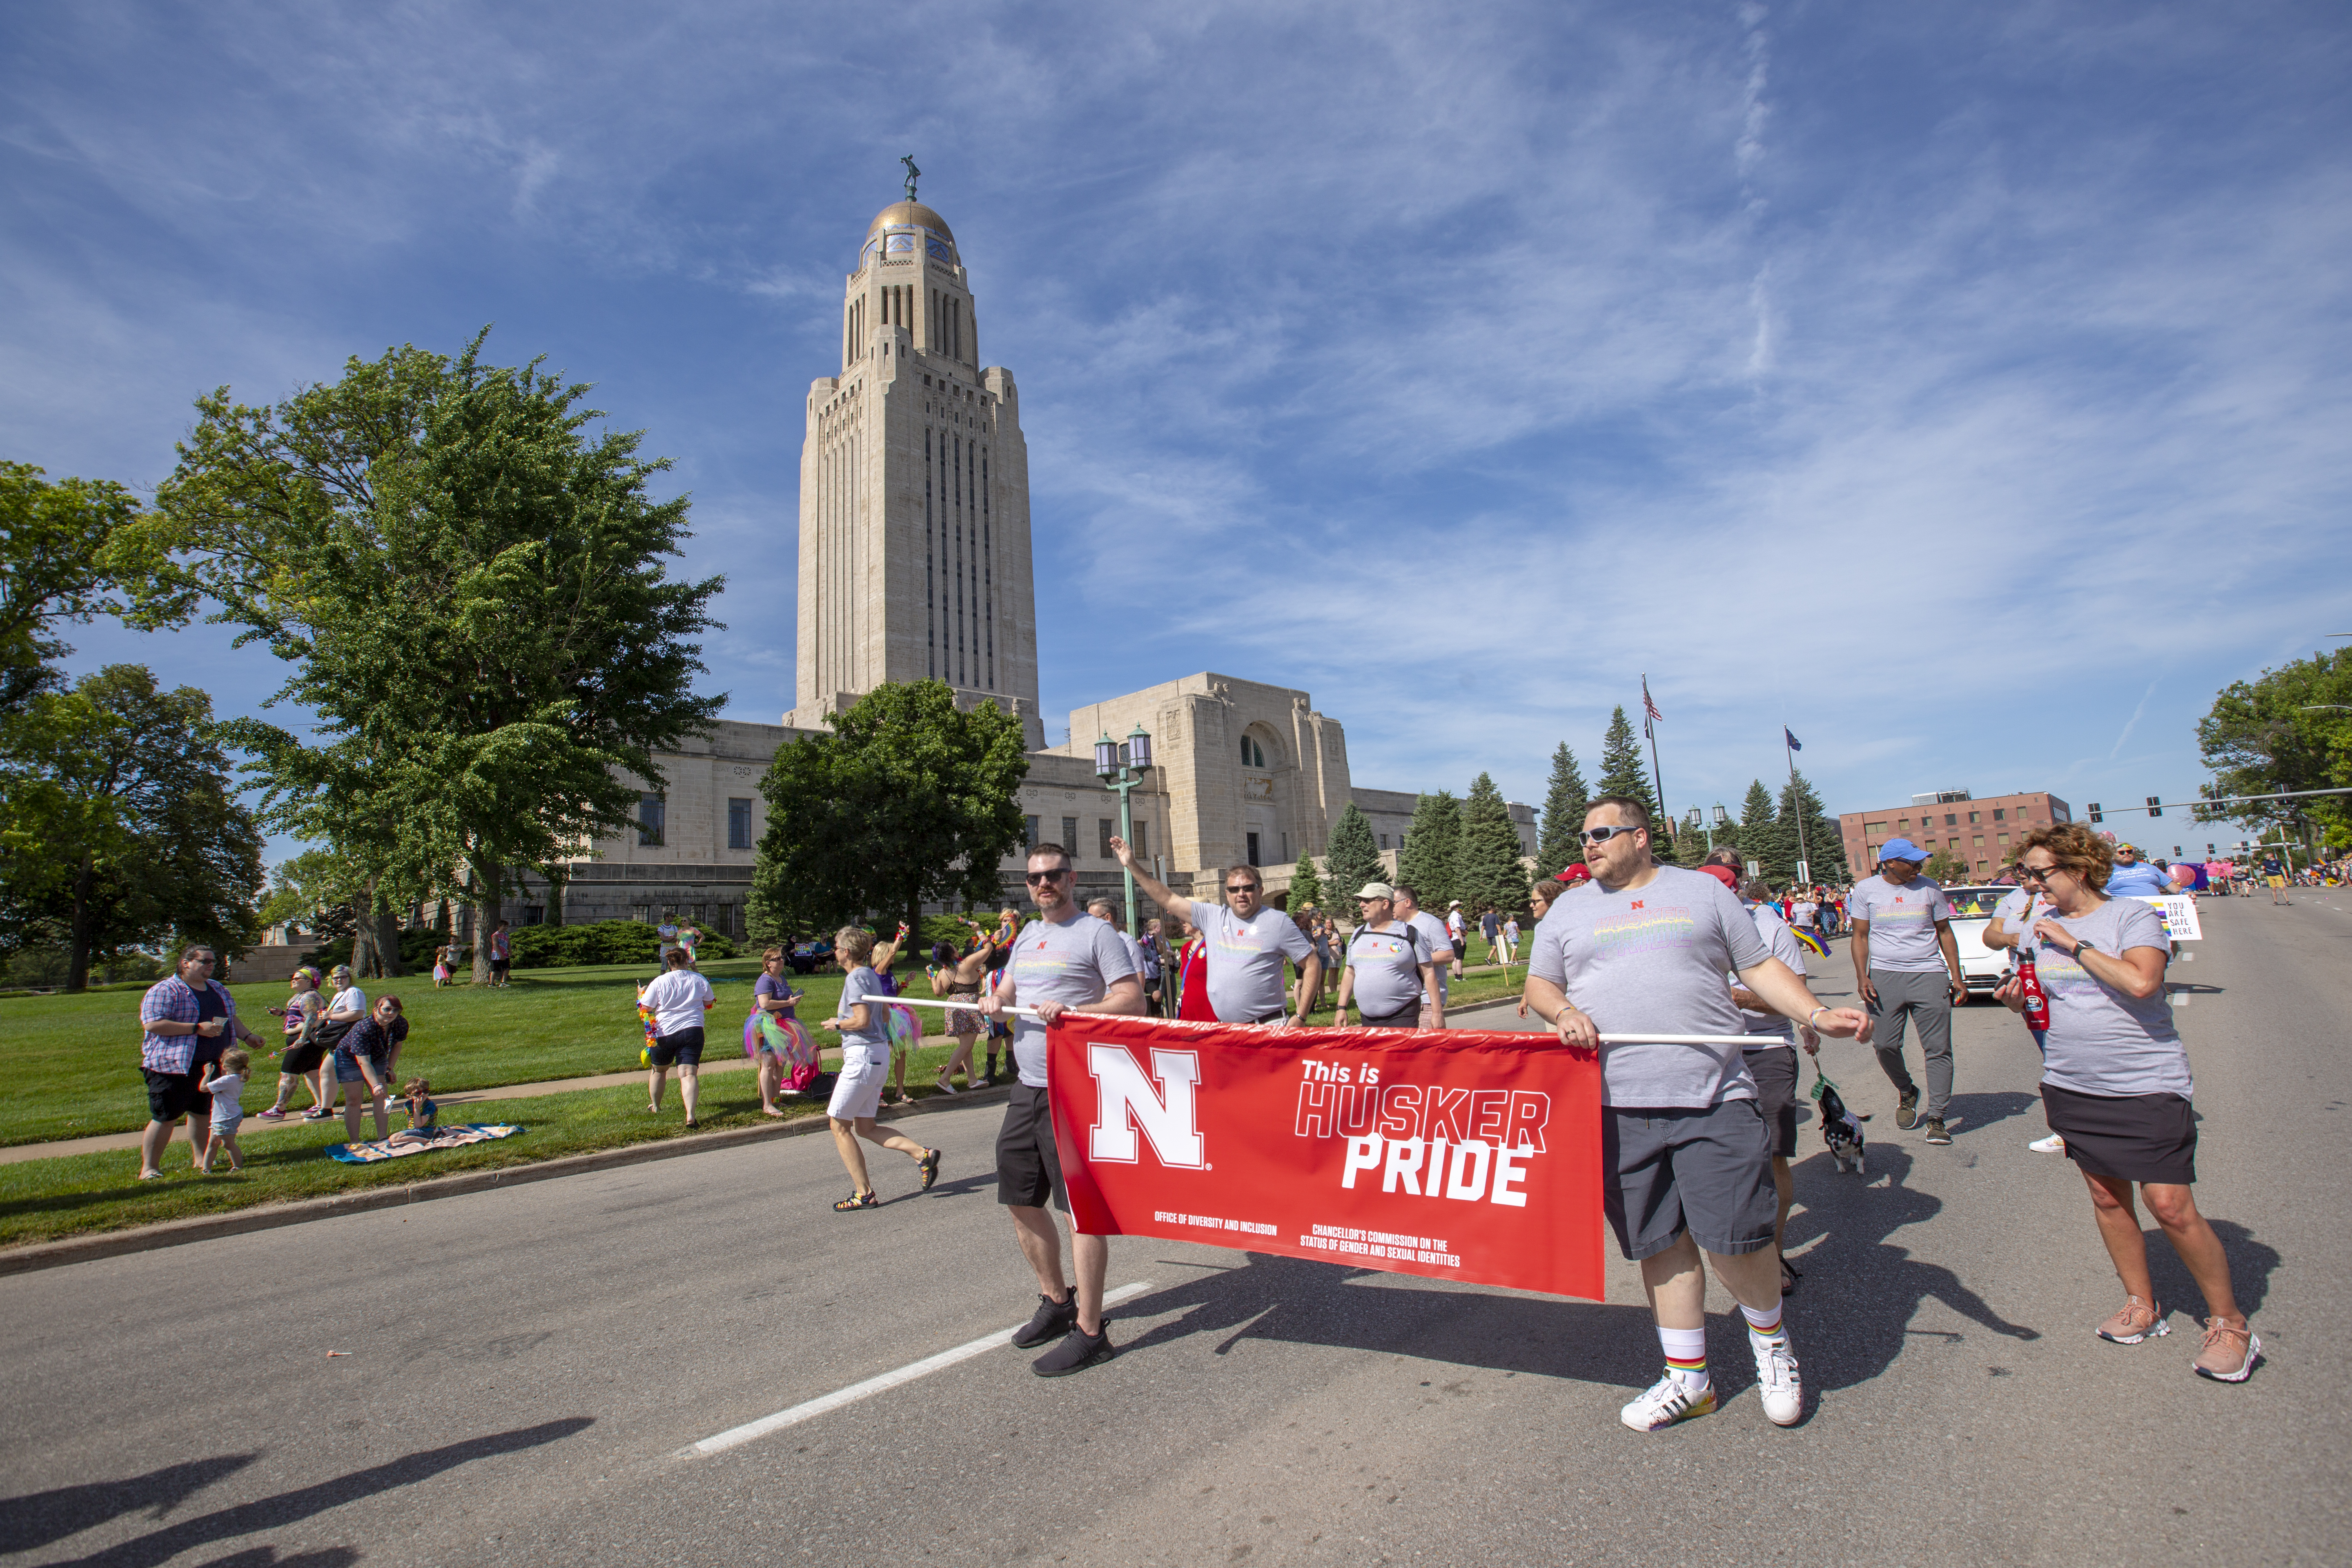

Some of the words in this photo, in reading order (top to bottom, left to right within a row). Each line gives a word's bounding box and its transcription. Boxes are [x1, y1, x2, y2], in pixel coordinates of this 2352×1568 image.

[1630, 900, 1644, 910] N
[1594, 906, 1693, 934] HUSKER
[1037, 941, 1047, 950] N
[1594, 920, 1693, 960] PRIDE
[1302, 1060, 1350, 1083] This
[1359, 1063, 1379, 1084] is
[1087, 1042, 1204, 1170] N
[1295, 1082, 1550, 1153] HUSKER
[1342, 1132, 1534, 1207] PRIDE
[1155, 1211, 1177, 1223] OFFICE
[1178, 1214, 1187, 1224] OF
[1188, 1215, 1223, 1229] DIVERSITY
[1224, 1219, 1238, 1231] AND
[1240, 1221, 1277, 1236] INCLUSION
[1301, 1235, 1327, 1249] STATUS
[1329, 1239, 1338, 1250] OF
[1339, 1241, 1368, 1255] GENDER
[1370, 1245, 1385, 1257] AND
[1387, 1247, 1416, 1261] SEXUAL
[1418, 1250, 1460, 1267] IDENTITIES
[1312, 1224, 1366, 1241] CHANCELLOR'S
[1368, 1231, 1418, 1248] COMMISSION
[1420, 1237, 1431, 1250] ON
[1433, 1239, 1448, 1252] THE
